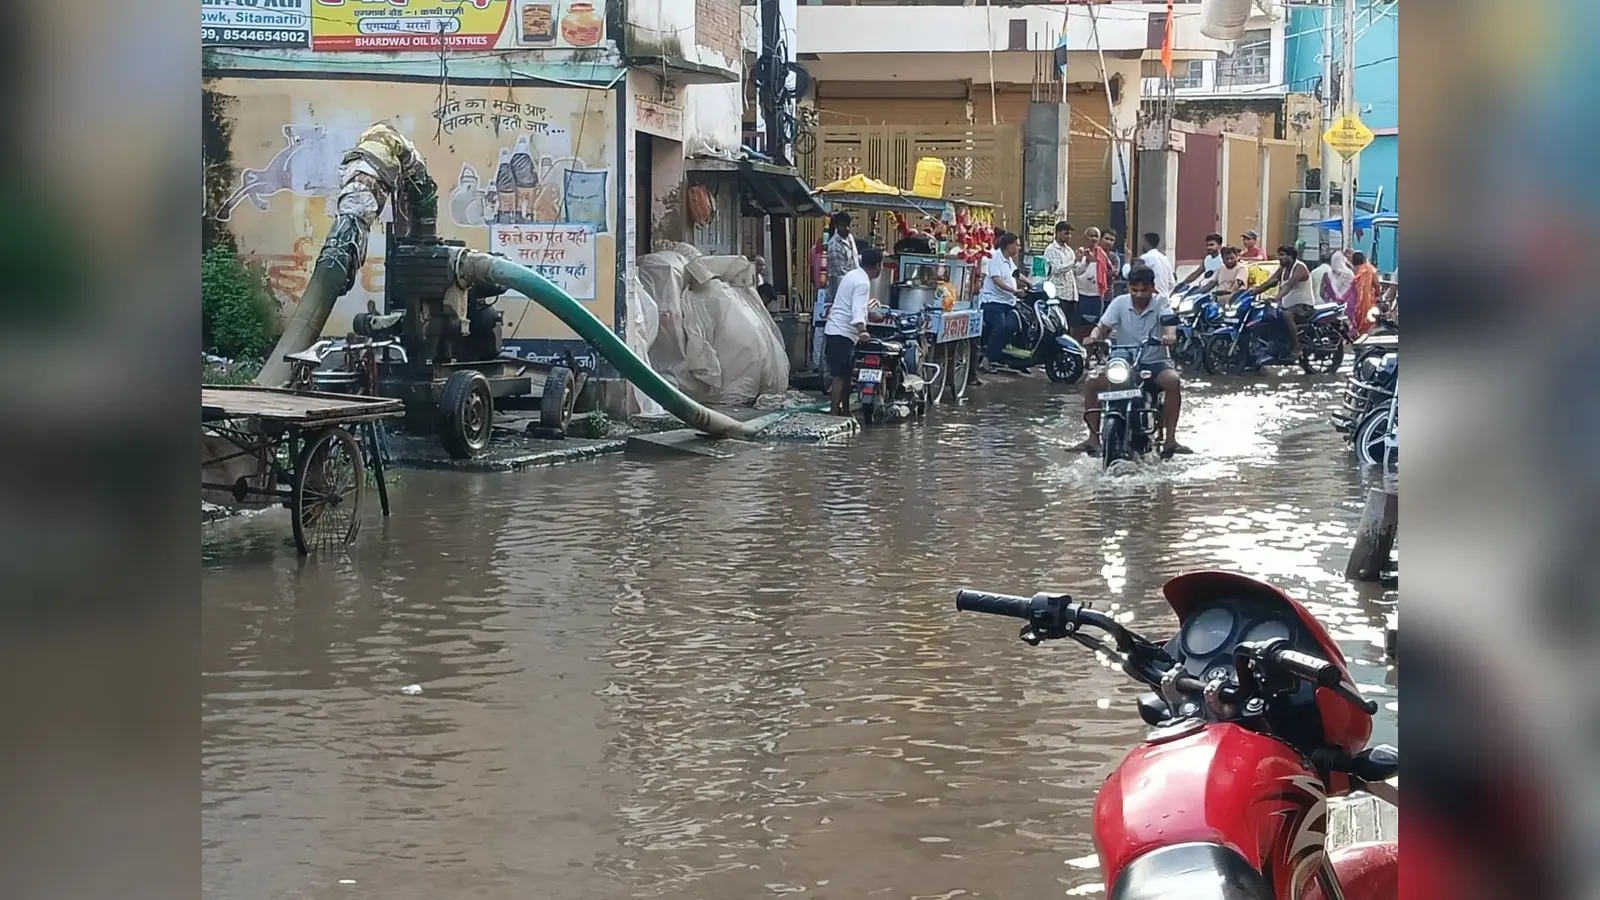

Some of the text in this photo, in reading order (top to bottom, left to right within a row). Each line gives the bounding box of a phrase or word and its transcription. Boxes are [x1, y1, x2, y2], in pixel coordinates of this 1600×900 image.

[236, 12, 302, 25] Sitamarhi
[405, 19, 431, 30] सरसों
[223, 30, 305, 42] 8544654902
[355, 38, 410, 46] BHARDWAJ
[413, 37, 428, 45] OIL
[465, 99, 486, 110] का
[493, 99, 521, 114] मजा
[443, 113, 485, 135] ताकत
[525, 231, 543, 244] का
[518, 248, 541, 260] मत
[565, 261, 588, 280] यहाँ
